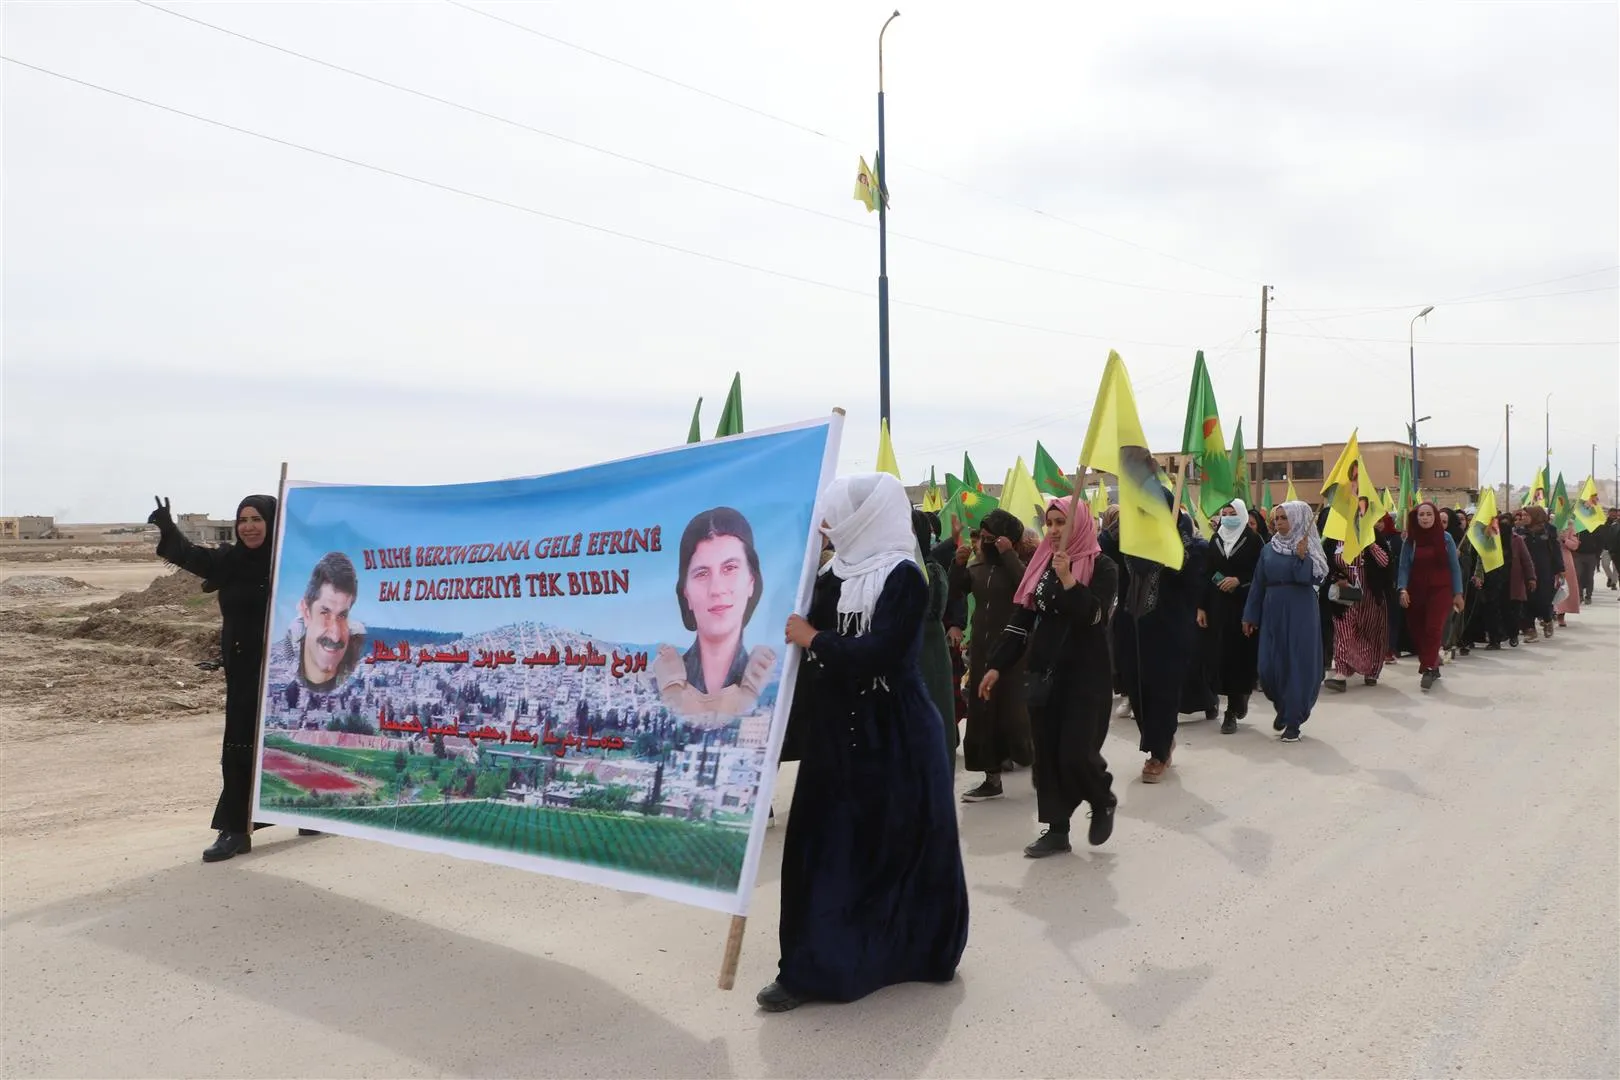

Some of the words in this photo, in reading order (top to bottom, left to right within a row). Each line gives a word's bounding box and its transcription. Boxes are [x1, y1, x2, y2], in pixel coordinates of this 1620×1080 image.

[362, 548, 378, 570] BI
[415, 539, 531, 567] BERXWEDANA
[534, 531, 584, 559] GELÊ
[586, 525, 663, 555] EFRÎNÊ
[378, 581, 401, 602] EM
[403, 578, 413, 601] Ê
[414, 572, 522, 601] DAGIRKERIYÊ
[525, 571, 565, 598] TÊK
[567, 569, 630, 596] BIBIN
[611, 649, 648, 679] بروح
